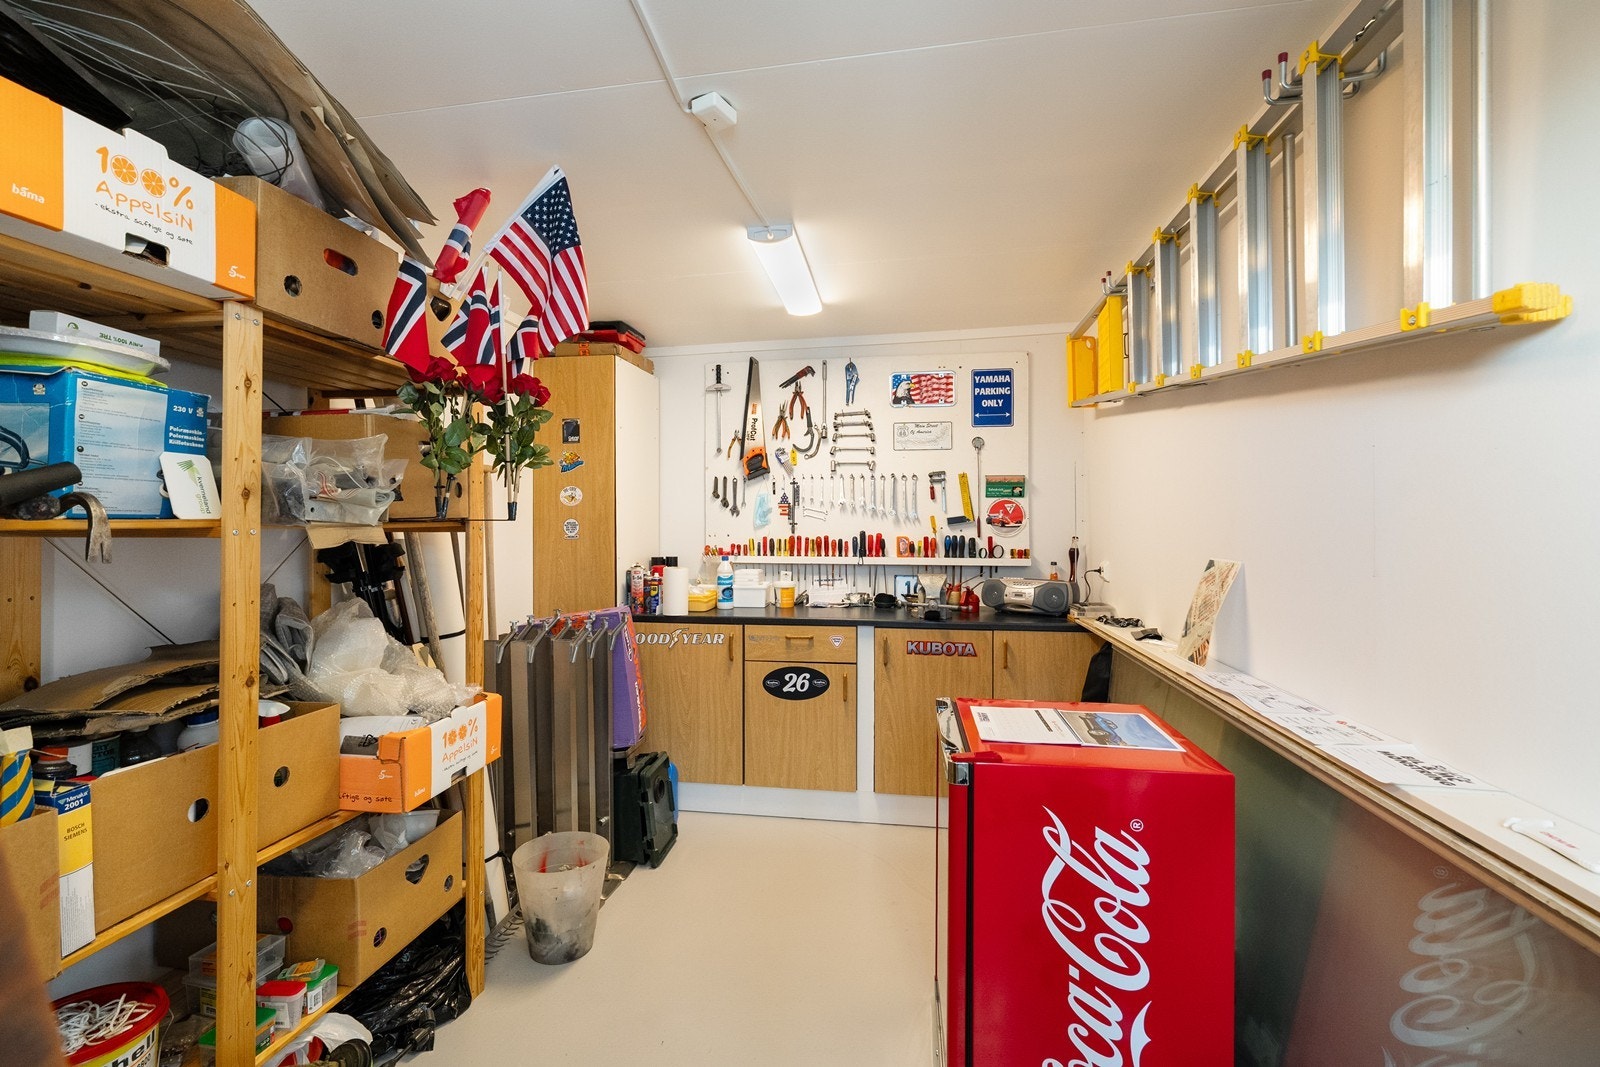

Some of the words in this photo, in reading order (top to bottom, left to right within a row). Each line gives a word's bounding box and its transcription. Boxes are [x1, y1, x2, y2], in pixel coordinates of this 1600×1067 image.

[96, 146, 194, 210] 100%
[134, 218, 162, 233] saftige
[166, 231, 175, 240] og
[974, 375, 1011, 384] YAMAHA
[974, 387, 1011, 396] PARKING
[173, 405, 186, 413] 230
[981, 399, 1004, 407] ONLY
[635, 630, 725, 646] OODYEAR
[907, 641, 976, 656] KUBOTA
[782, 672, 811, 693] 26
[64, 798, 84, 811] 2001
[338, 792, 360, 803] ftige
[66, 822, 85, 833] BOSCH
[63, 828, 88, 842] SIEMENS
[1041, 805, 1151, 1067] ca-Cola
[111, 1029, 155, 1067] hell
